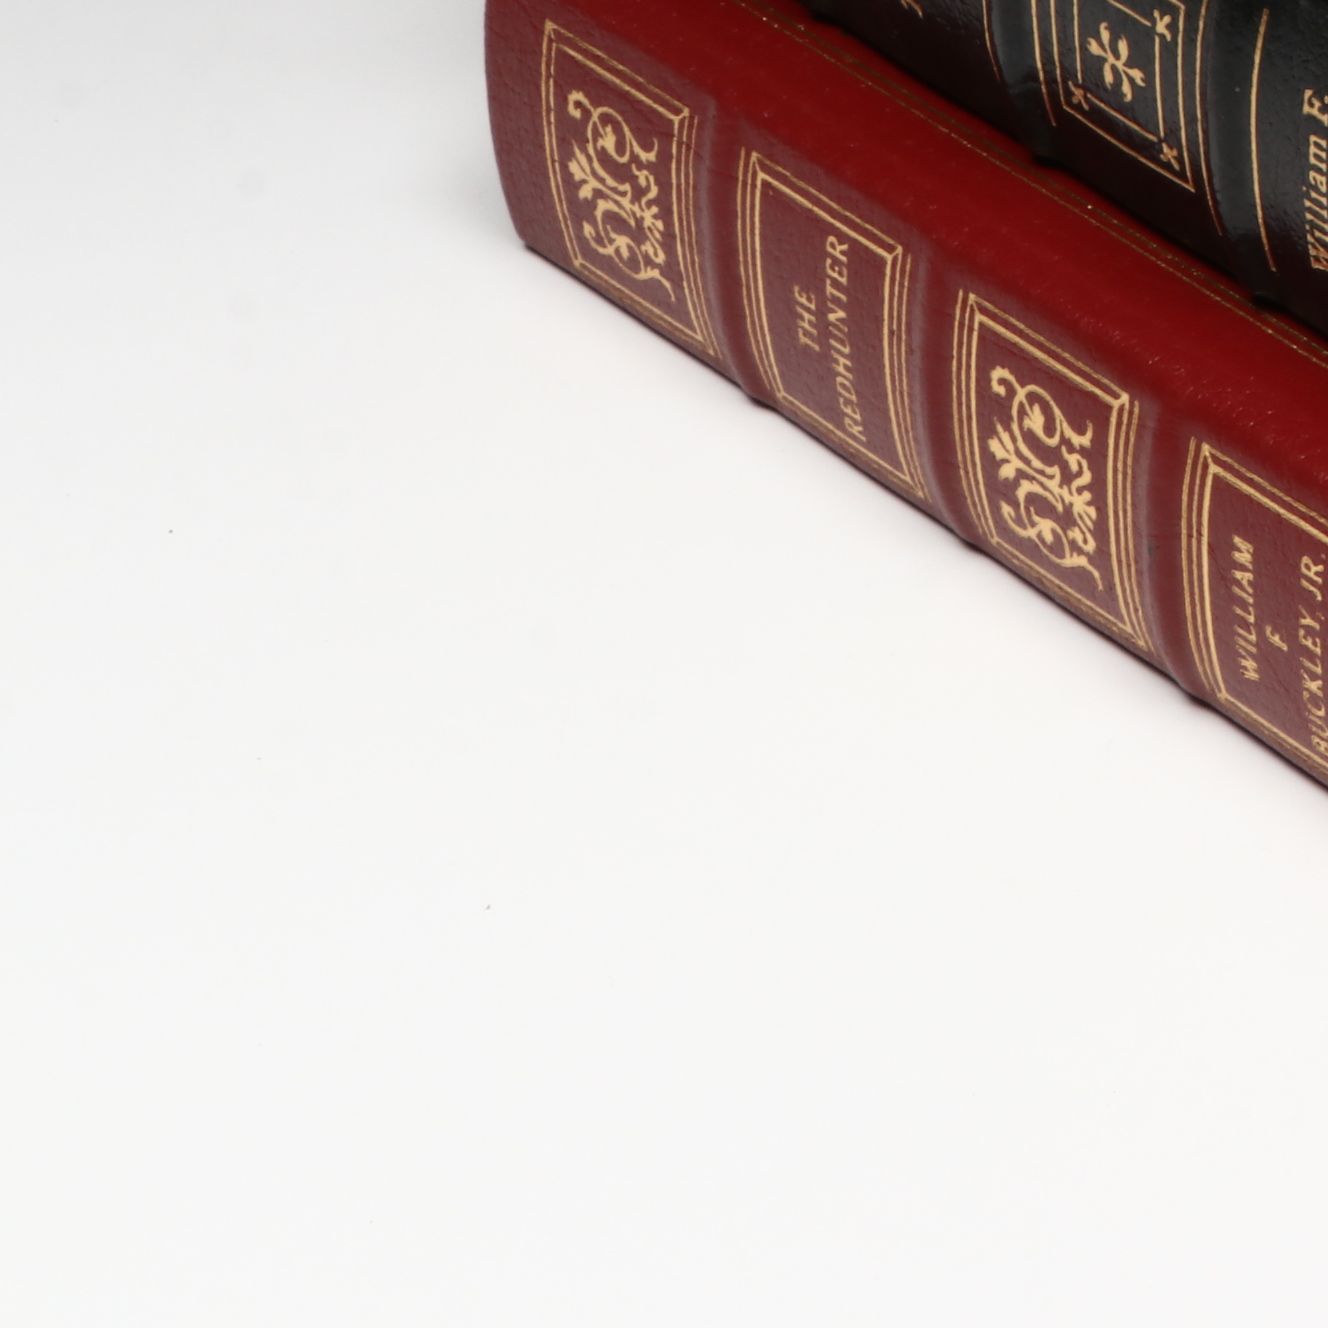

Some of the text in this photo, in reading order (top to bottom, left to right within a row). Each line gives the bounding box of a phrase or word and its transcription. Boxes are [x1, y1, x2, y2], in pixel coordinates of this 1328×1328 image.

[793, 284, 820, 352] THE
[825, 235, 867, 443] REDHUNTER
[1231, 534, 1260, 682] WILLIAM
[1300, 553, 1327, 602] JR.
[1265, 624, 1288, 653] F
